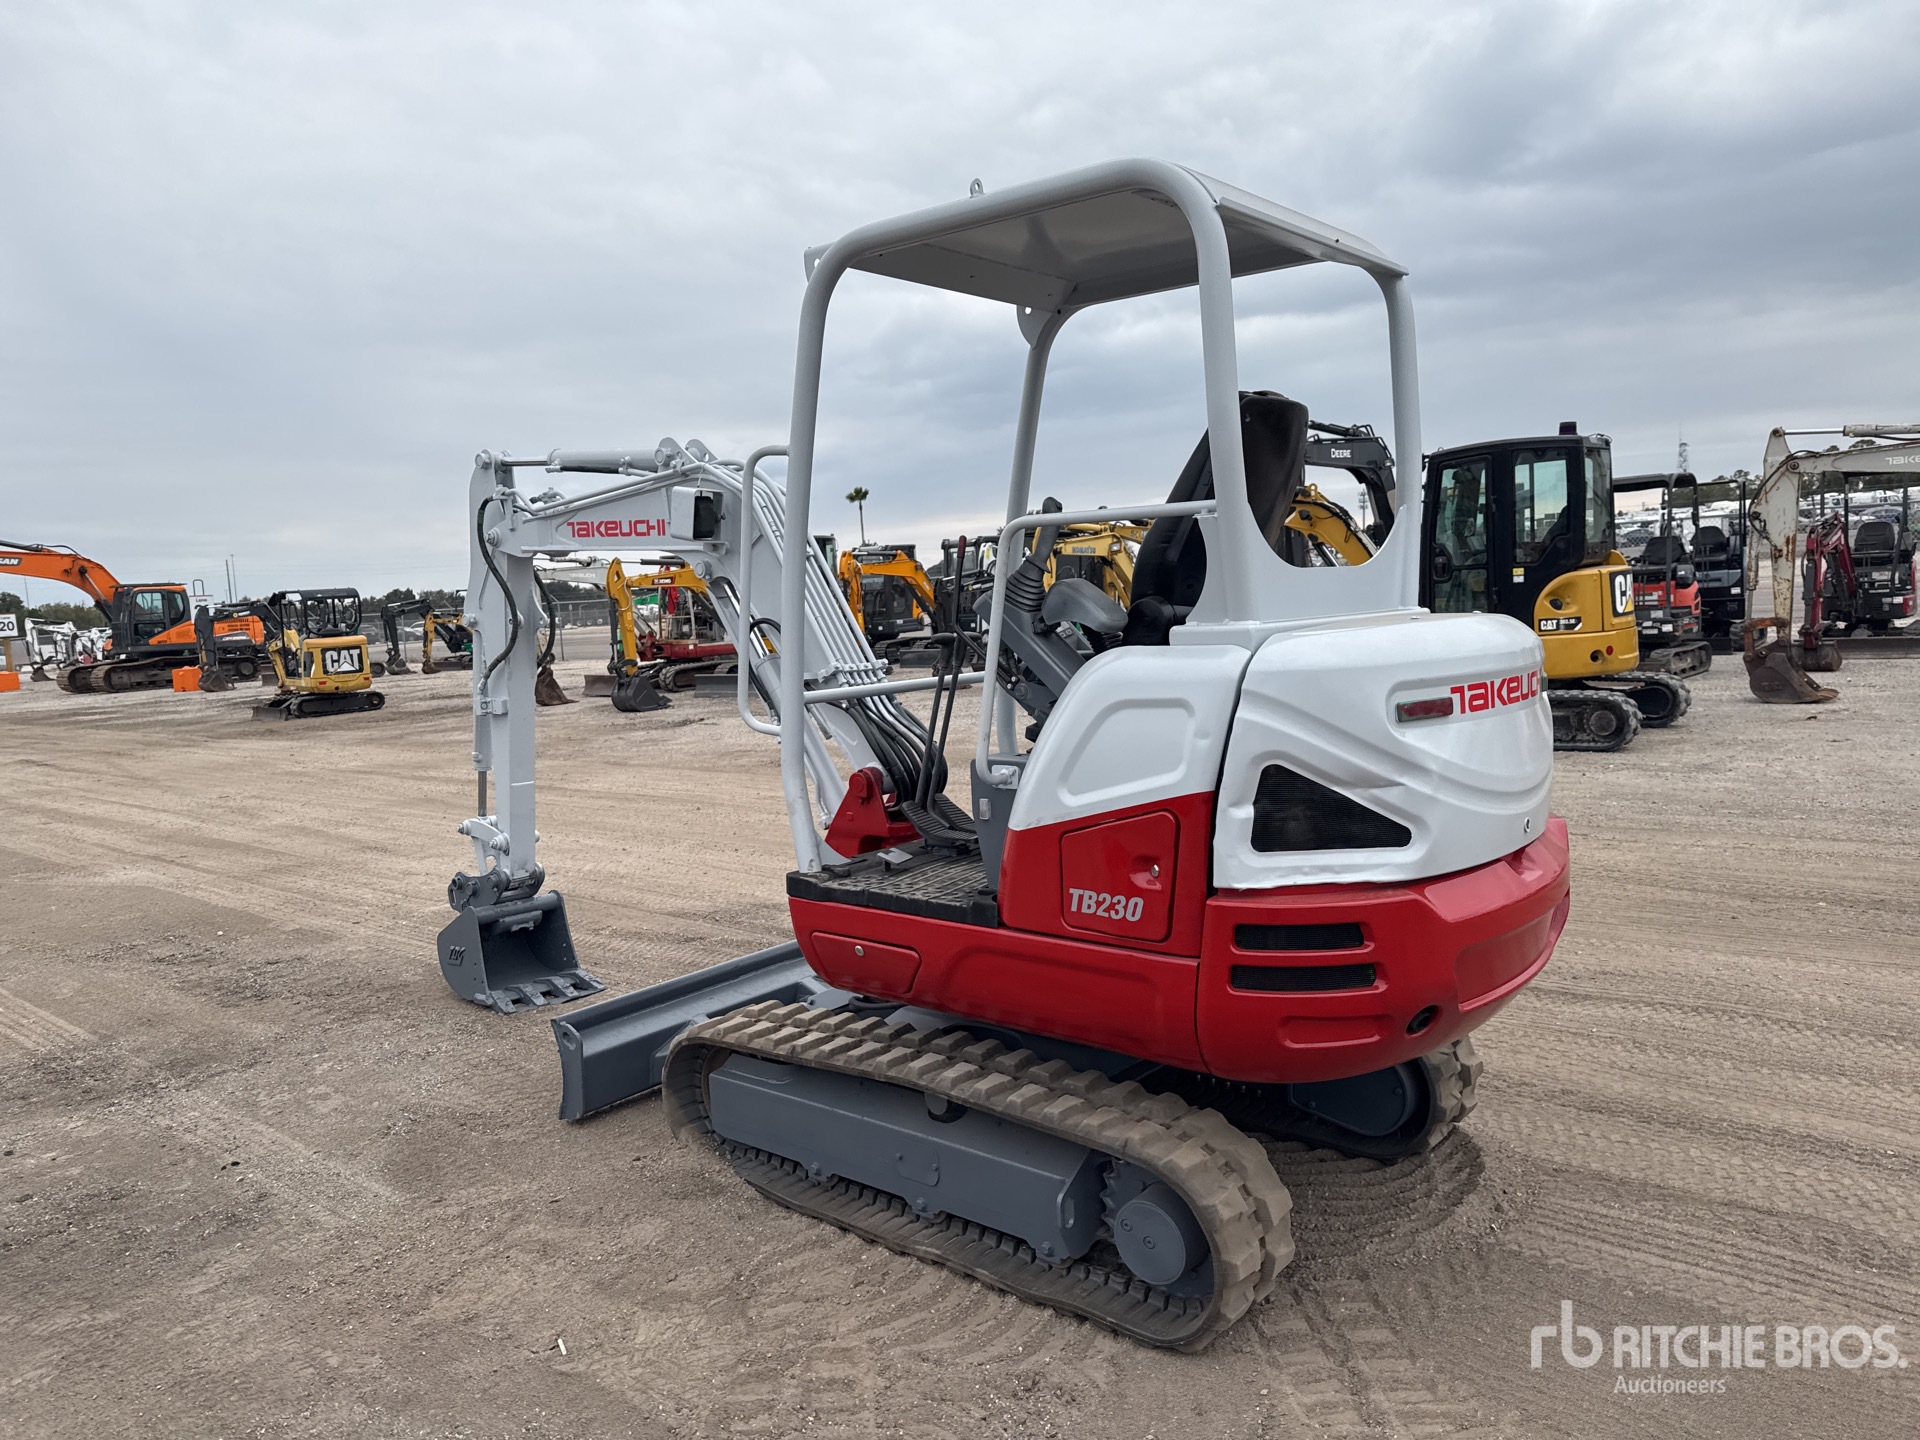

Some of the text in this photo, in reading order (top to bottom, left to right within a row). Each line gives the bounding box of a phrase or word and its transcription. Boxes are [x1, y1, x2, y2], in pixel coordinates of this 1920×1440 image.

[1331, 448, 1352, 458] DEERE
[566, 518, 666, 538] TAKEUCHI
[1615, 573, 1634, 614] CA
[1540, 619, 1558, 631] CAT
[325, 649, 360, 674] CAT
[1069, 888, 1144, 922] TB230
